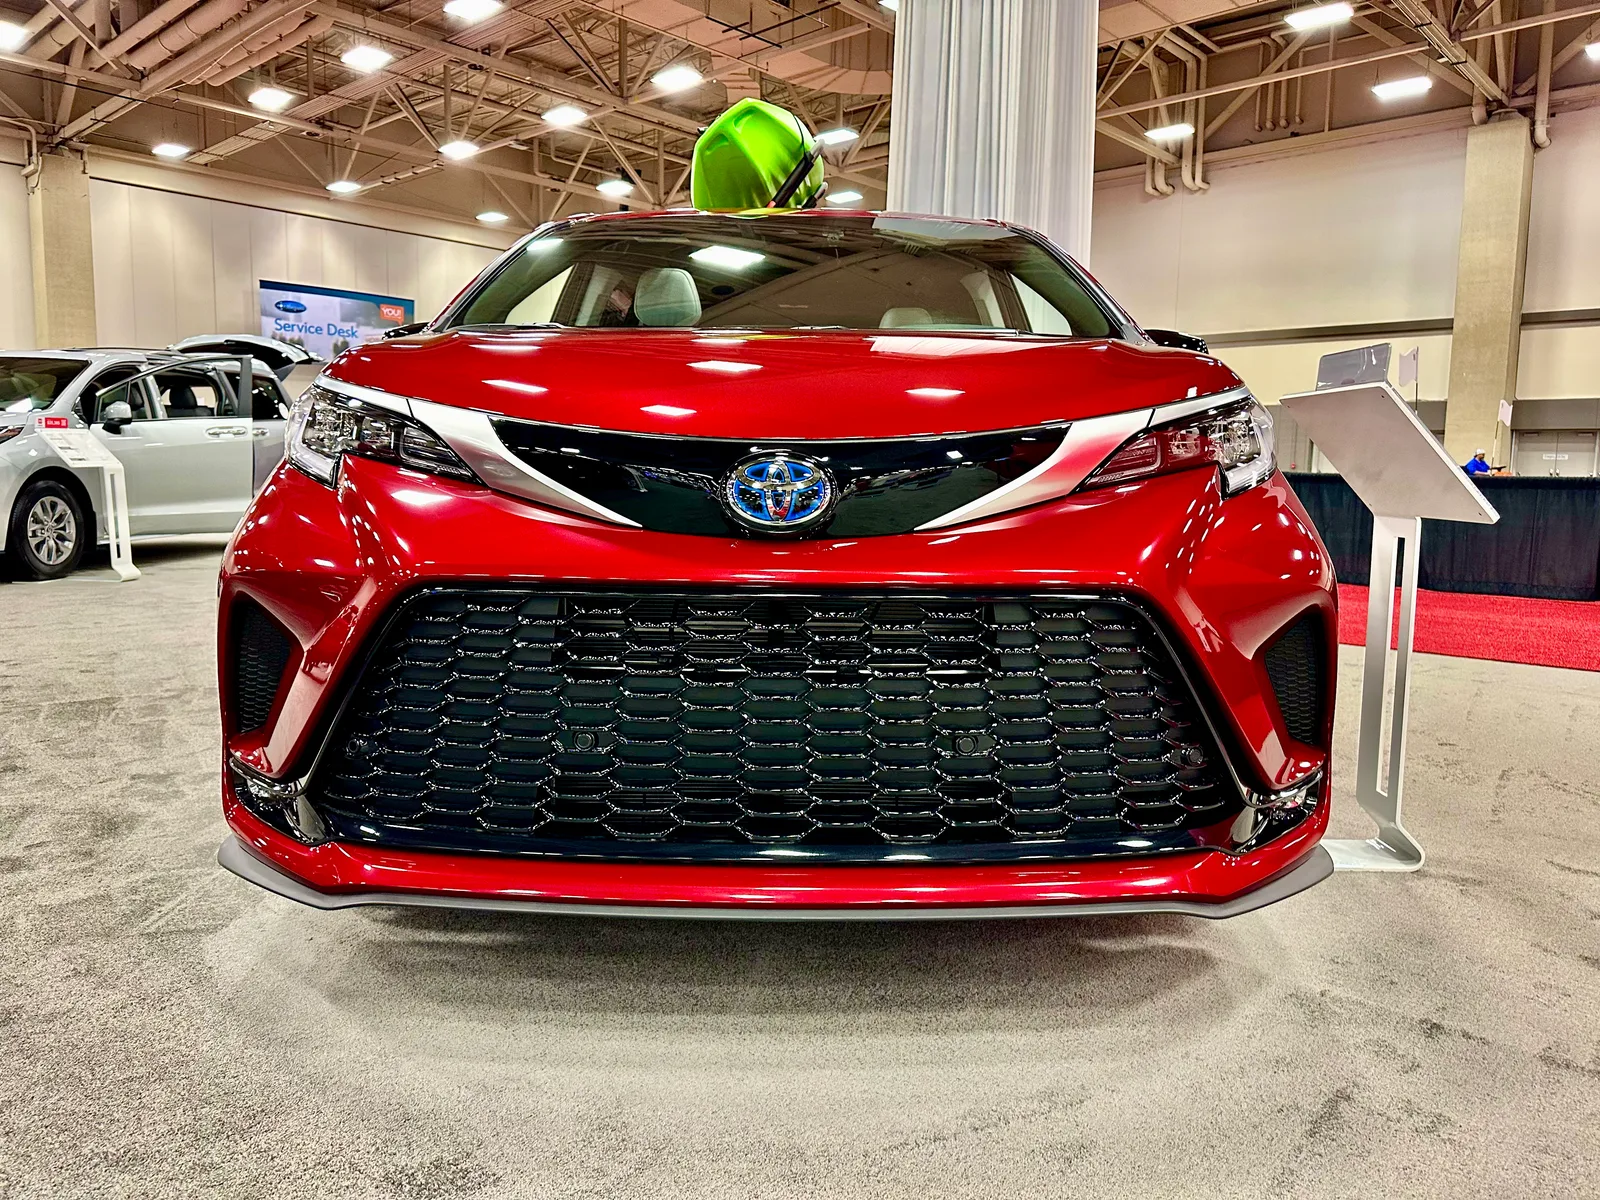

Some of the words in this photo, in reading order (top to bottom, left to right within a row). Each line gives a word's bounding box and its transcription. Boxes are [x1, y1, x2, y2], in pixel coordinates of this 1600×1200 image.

[381, 307, 402, 317] YOU!
[274, 317, 323, 335] Service
[327, 323, 358, 338] Desk
